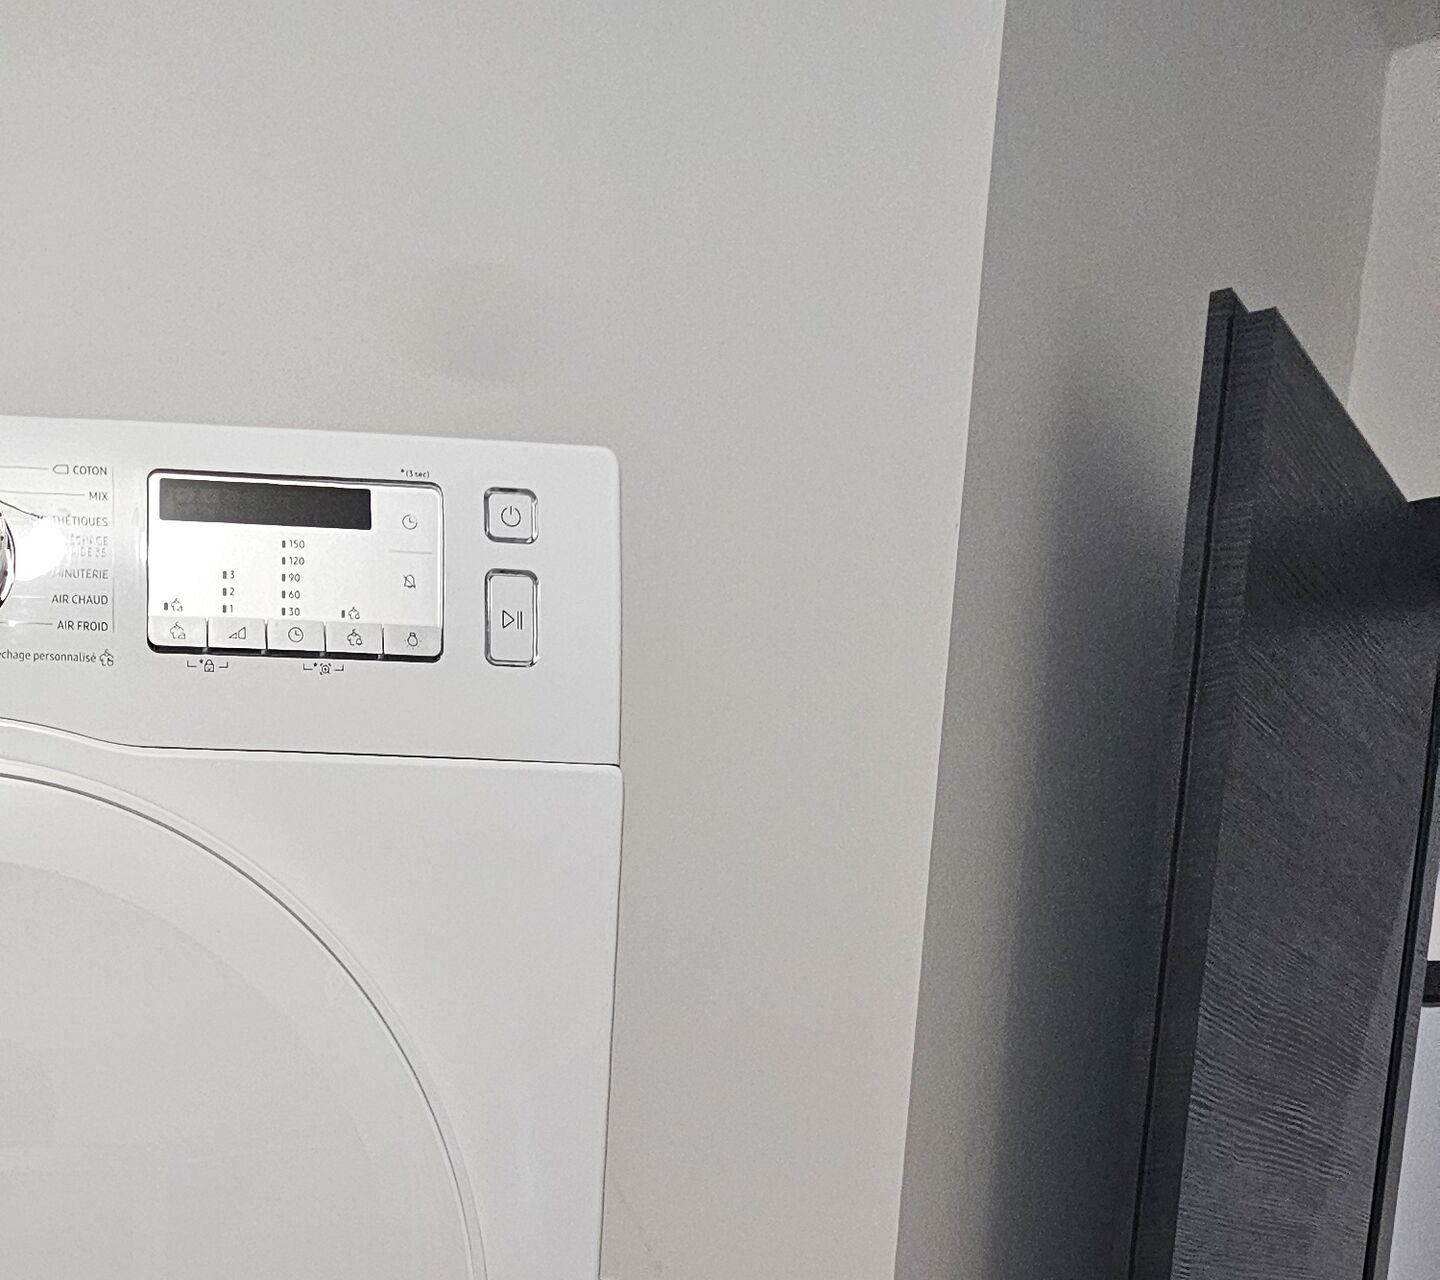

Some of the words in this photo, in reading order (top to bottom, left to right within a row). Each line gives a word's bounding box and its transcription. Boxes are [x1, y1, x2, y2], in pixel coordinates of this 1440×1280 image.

[72, 465, 107, 477] COTON
[89, 491, 109, 501] MIX
[289, 539, 305, 549] 150
[289, 556, 305, 566] 120
[288, 573, 300, 582] 90
[51, 594, 69, 604] AIR
[72, 594, 108, 605] CHAUD
[288, 590, 300, 599] 60
[288, 607, 300, 616] 30
[57, 620, 74, 630] AIR
[77, 621, 108, 631] FROID
[33, 651, 97, 663] personnalisé
